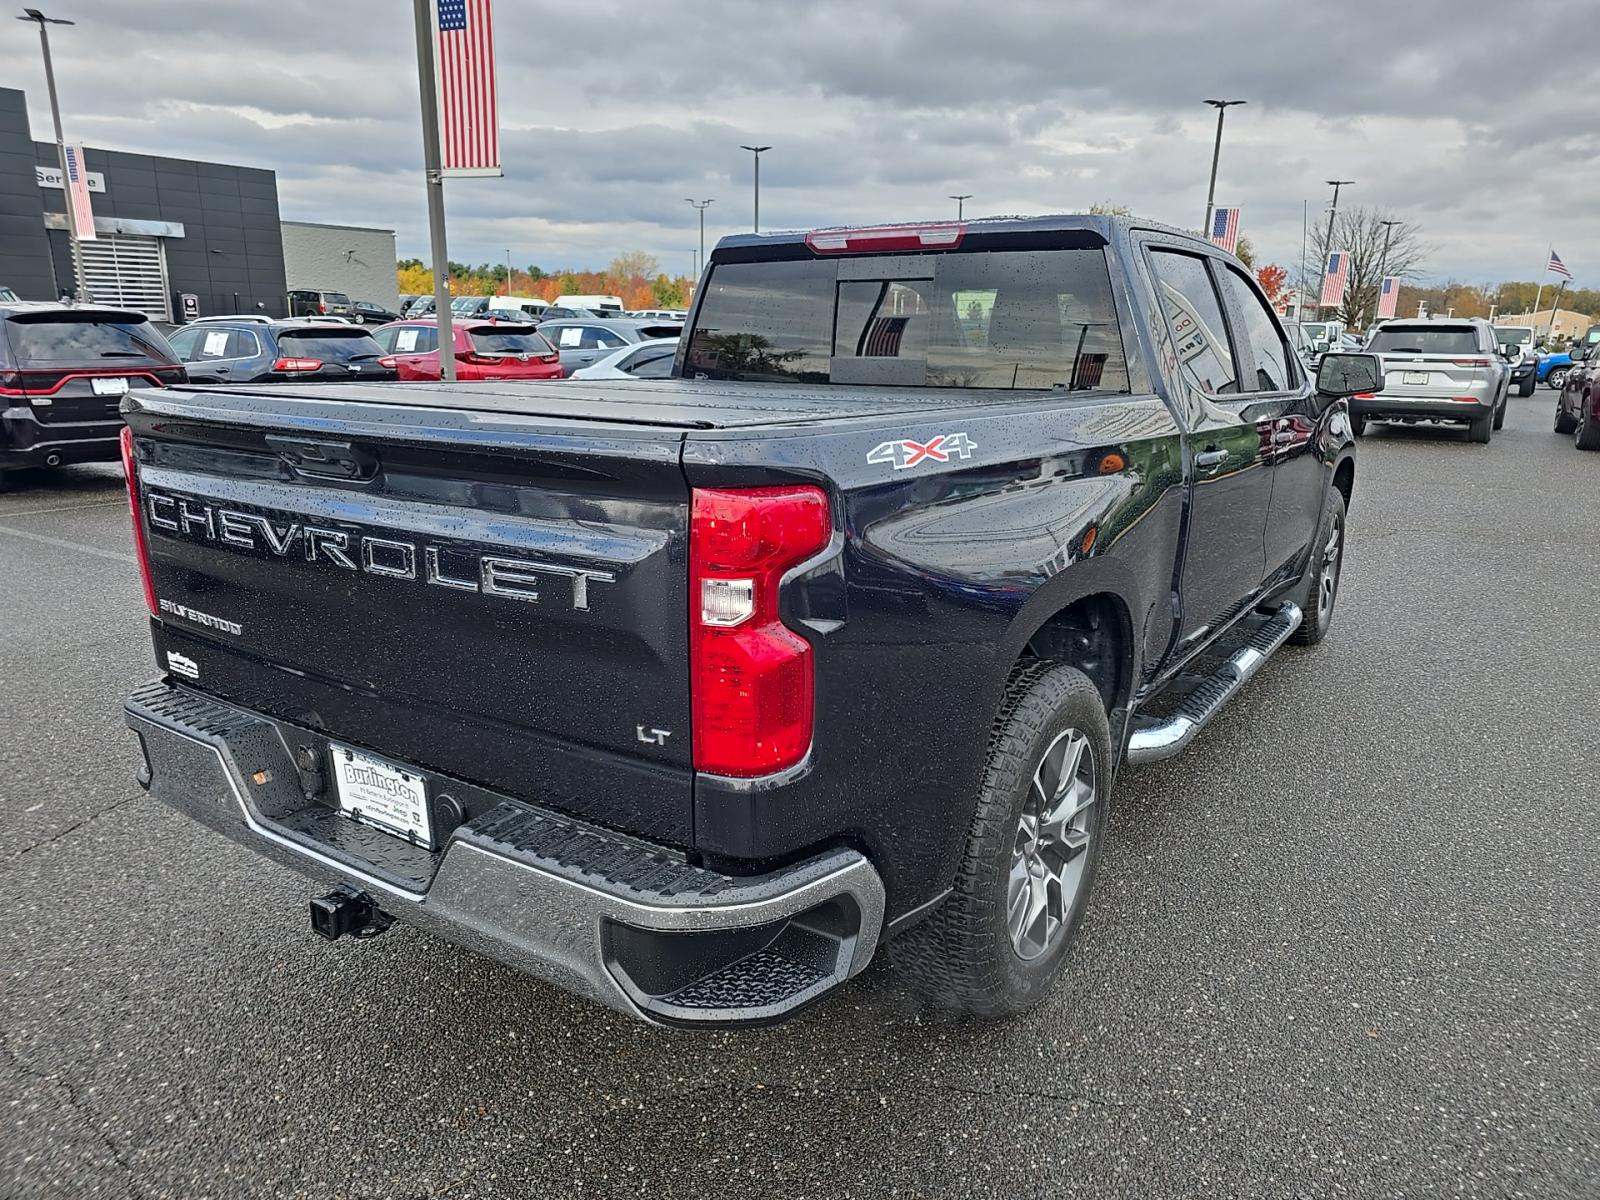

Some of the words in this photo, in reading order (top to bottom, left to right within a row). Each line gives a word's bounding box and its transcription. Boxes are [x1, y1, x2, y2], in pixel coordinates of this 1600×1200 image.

[36, 171, 96, 187] Sere
[148, 493, 616, 612] CHEVROLET
[160, 599, 242, 635] SILVERADO
[636, 725, 672, 746] LT
[344, 763, 420, 807] Burlington
